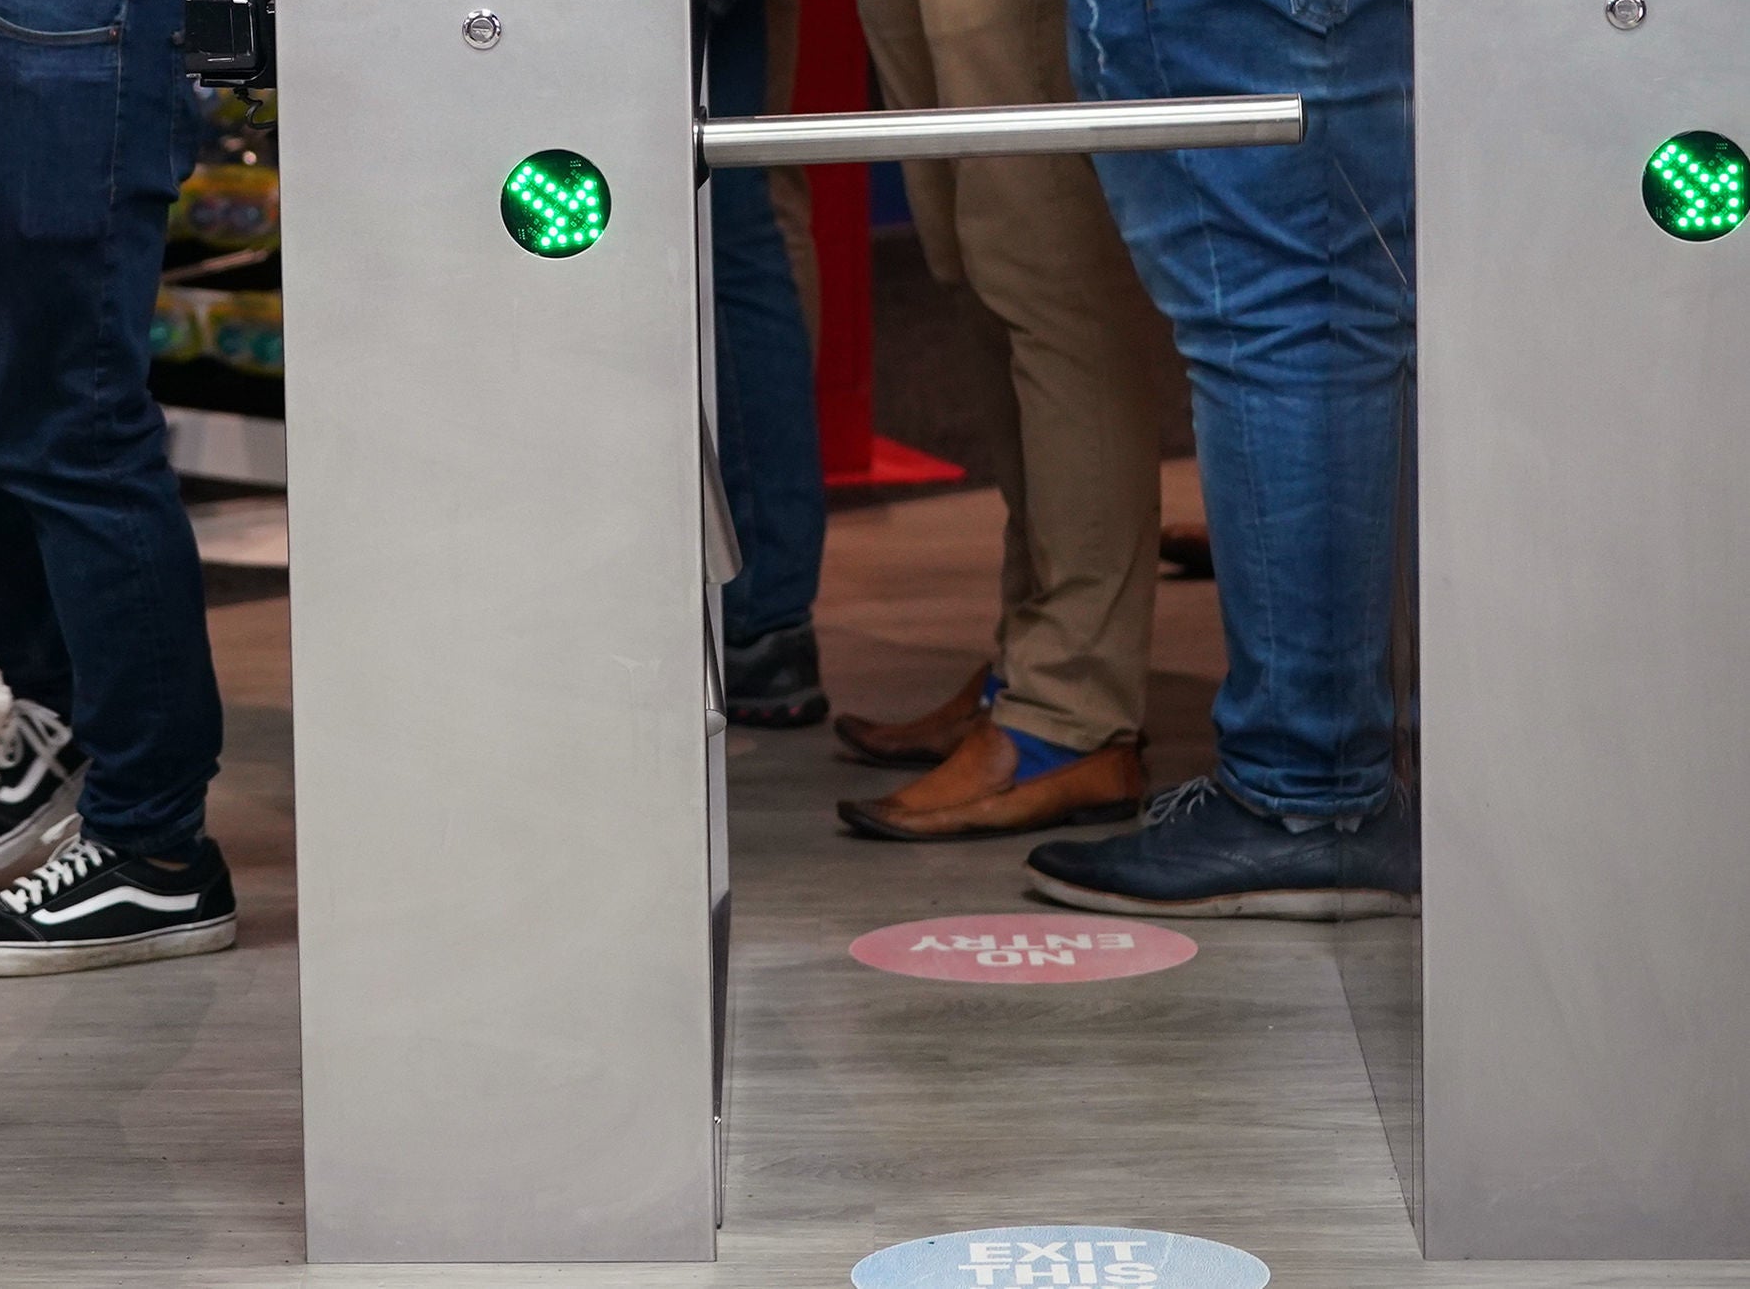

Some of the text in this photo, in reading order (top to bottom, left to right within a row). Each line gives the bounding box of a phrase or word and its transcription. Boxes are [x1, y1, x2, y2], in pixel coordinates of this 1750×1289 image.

[910, 933, 1135, 952] ENTRY
[976, 949, 1076, 967] NO
[969, 1241, 1148, 1262] EXIT
[958, 1262, 1158, 1286] THIS
